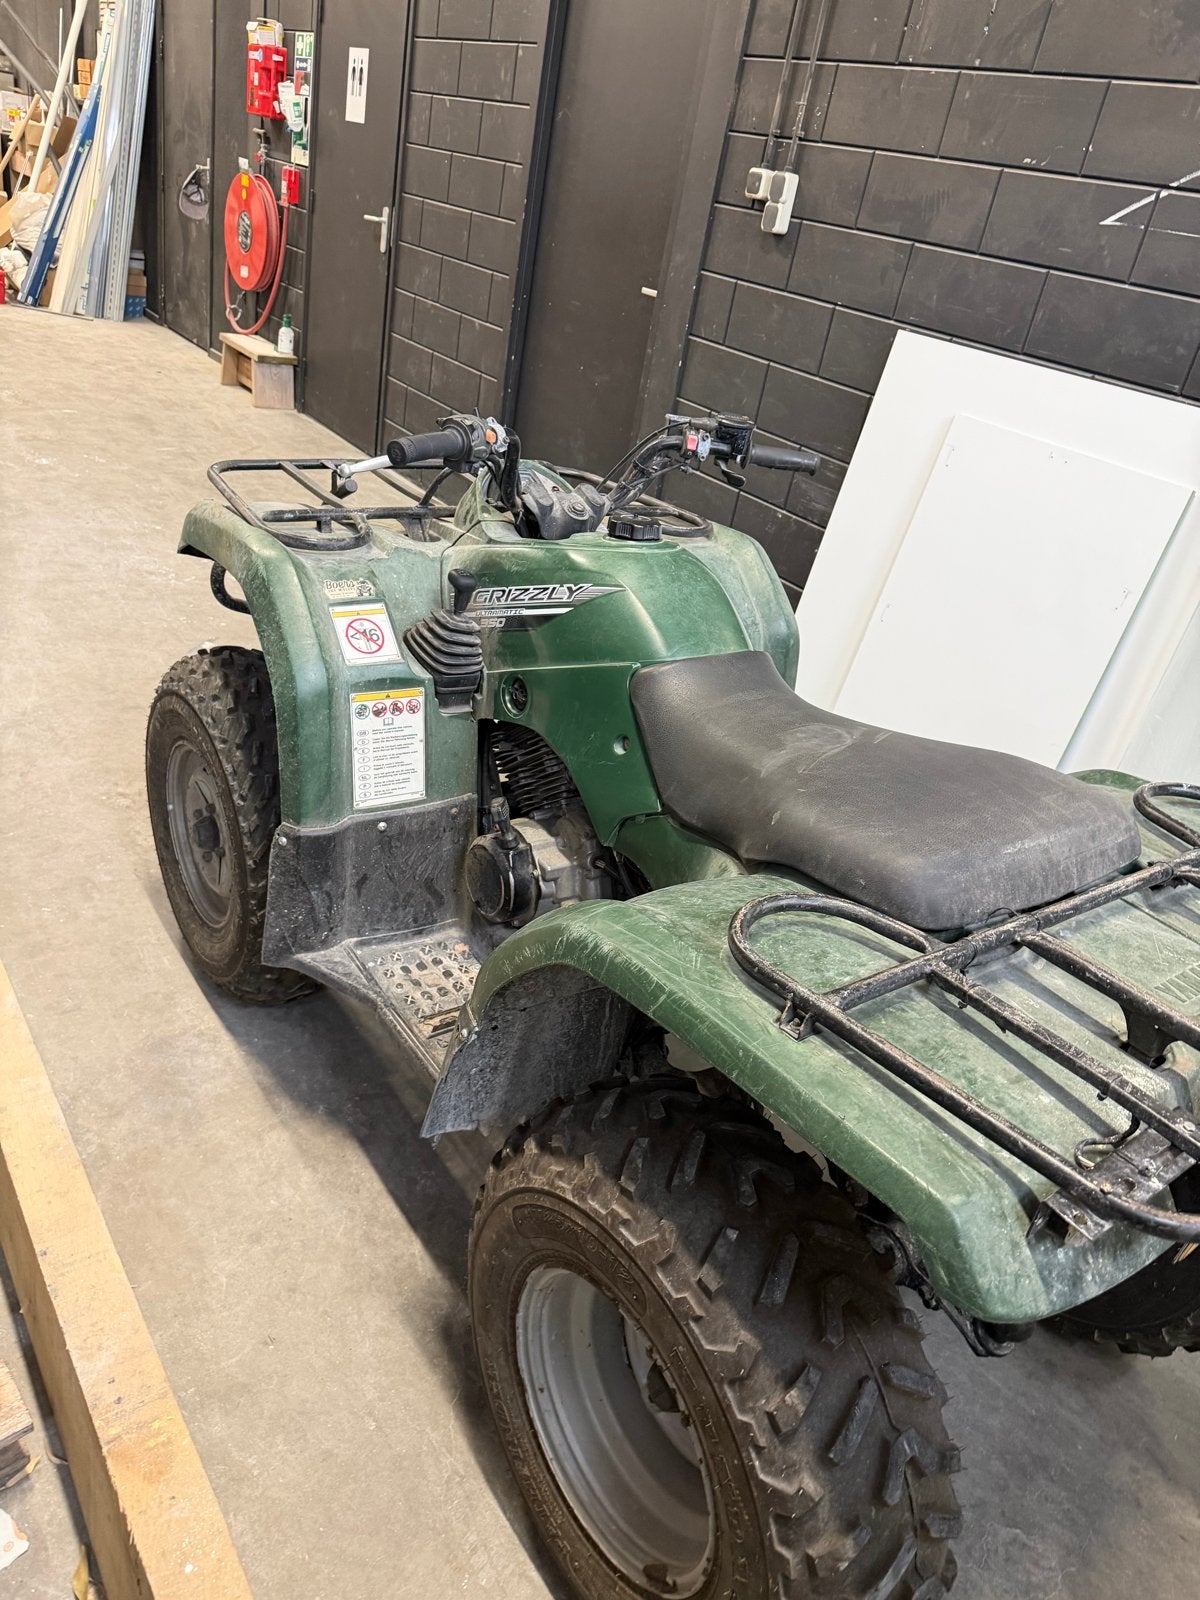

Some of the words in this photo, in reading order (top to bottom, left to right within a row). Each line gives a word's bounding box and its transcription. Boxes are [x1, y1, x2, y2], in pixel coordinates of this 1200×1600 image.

[473, 584, 592, 605] GRIZZLY
[475, 608, 524, 616] ULTRAMATIC
[480, 618, 506, 628] 350
